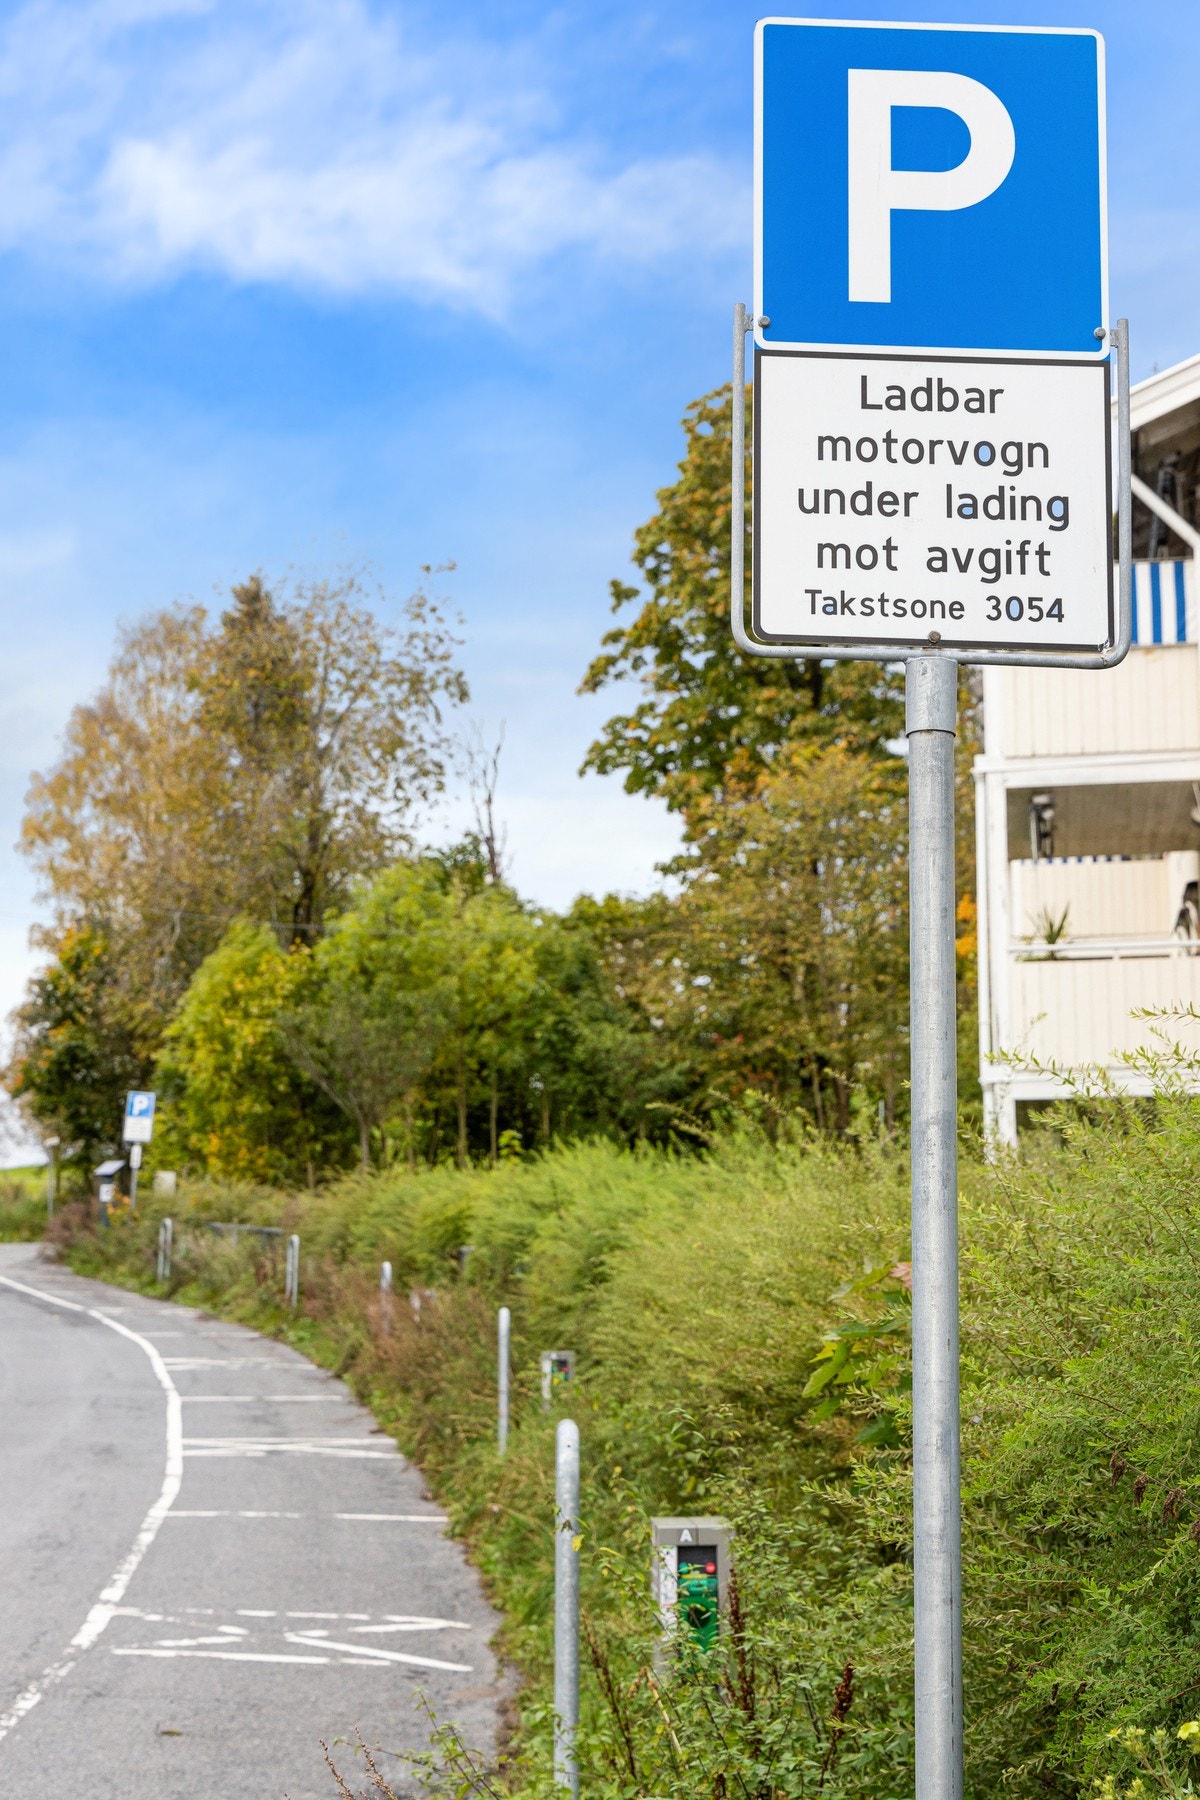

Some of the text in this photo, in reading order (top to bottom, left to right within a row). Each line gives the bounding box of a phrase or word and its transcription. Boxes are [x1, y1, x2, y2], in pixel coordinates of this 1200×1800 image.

[847, 69, 1016, 304] P
[860, 374, 1005, 414] Ladbar
[817, 429, 1050, 477] motorvogn
[798, 481, 1070, 532] under lading
[816, 536, 1051, 584] mot avgift
[804, 588, 1065, 623] Takstsone 3054
[132, 1095, 149, 1116] P
[679, 1529, 693, 1543] A
